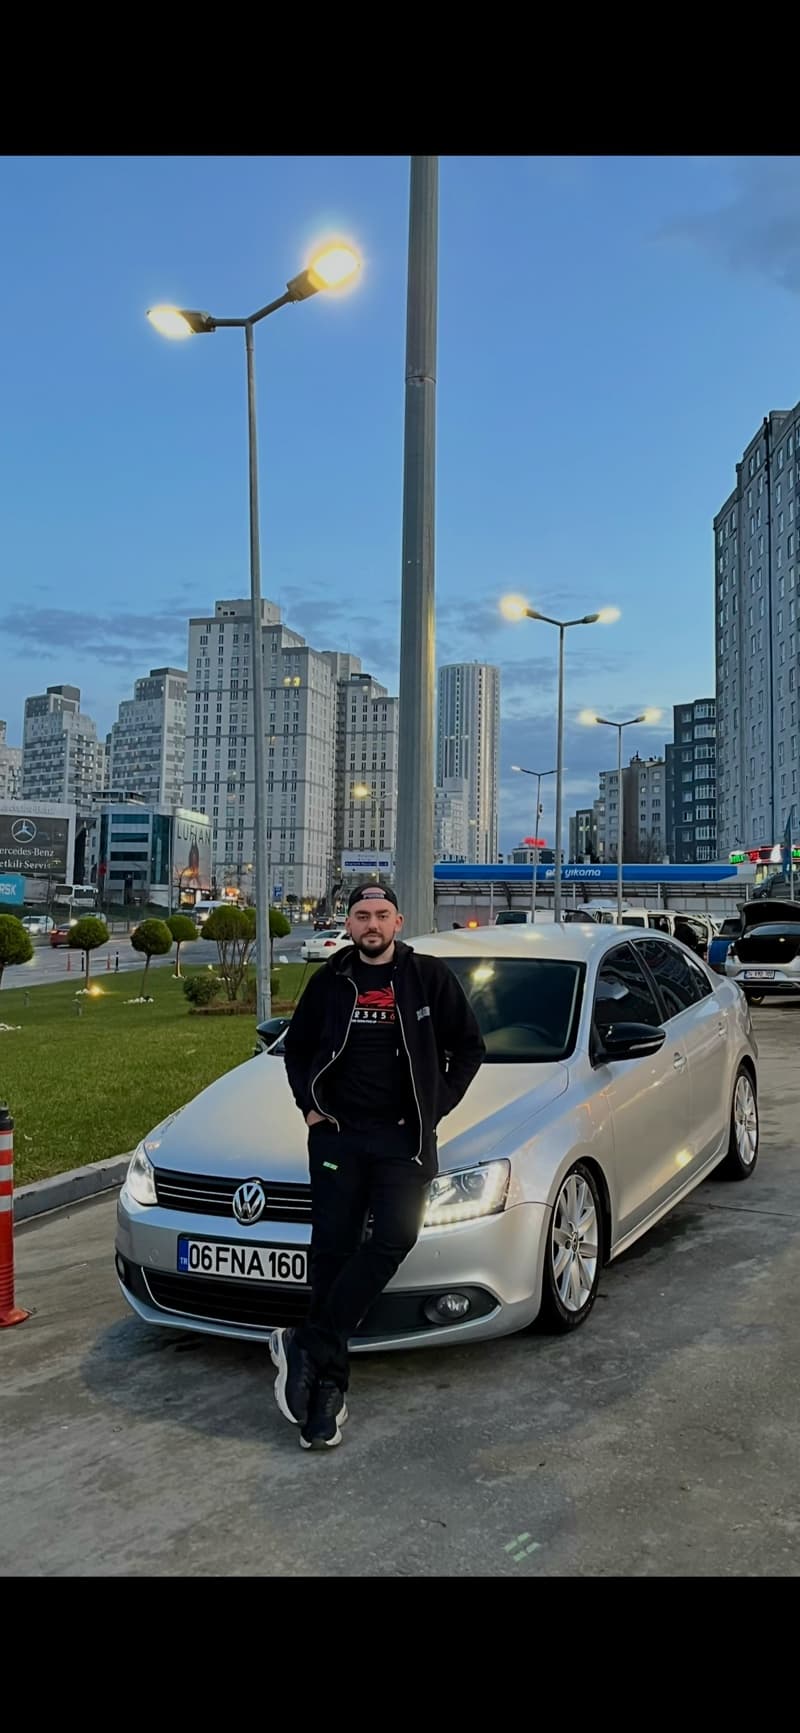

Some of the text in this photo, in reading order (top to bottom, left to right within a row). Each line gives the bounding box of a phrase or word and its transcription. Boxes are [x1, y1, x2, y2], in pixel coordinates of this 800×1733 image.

[0, 847, 54, 857] ercedes-Benz
[0, 859, 22, 869] etkili
[371, 1011, 377, 1020] 4
[380, 1012, 387, 1020] 5
